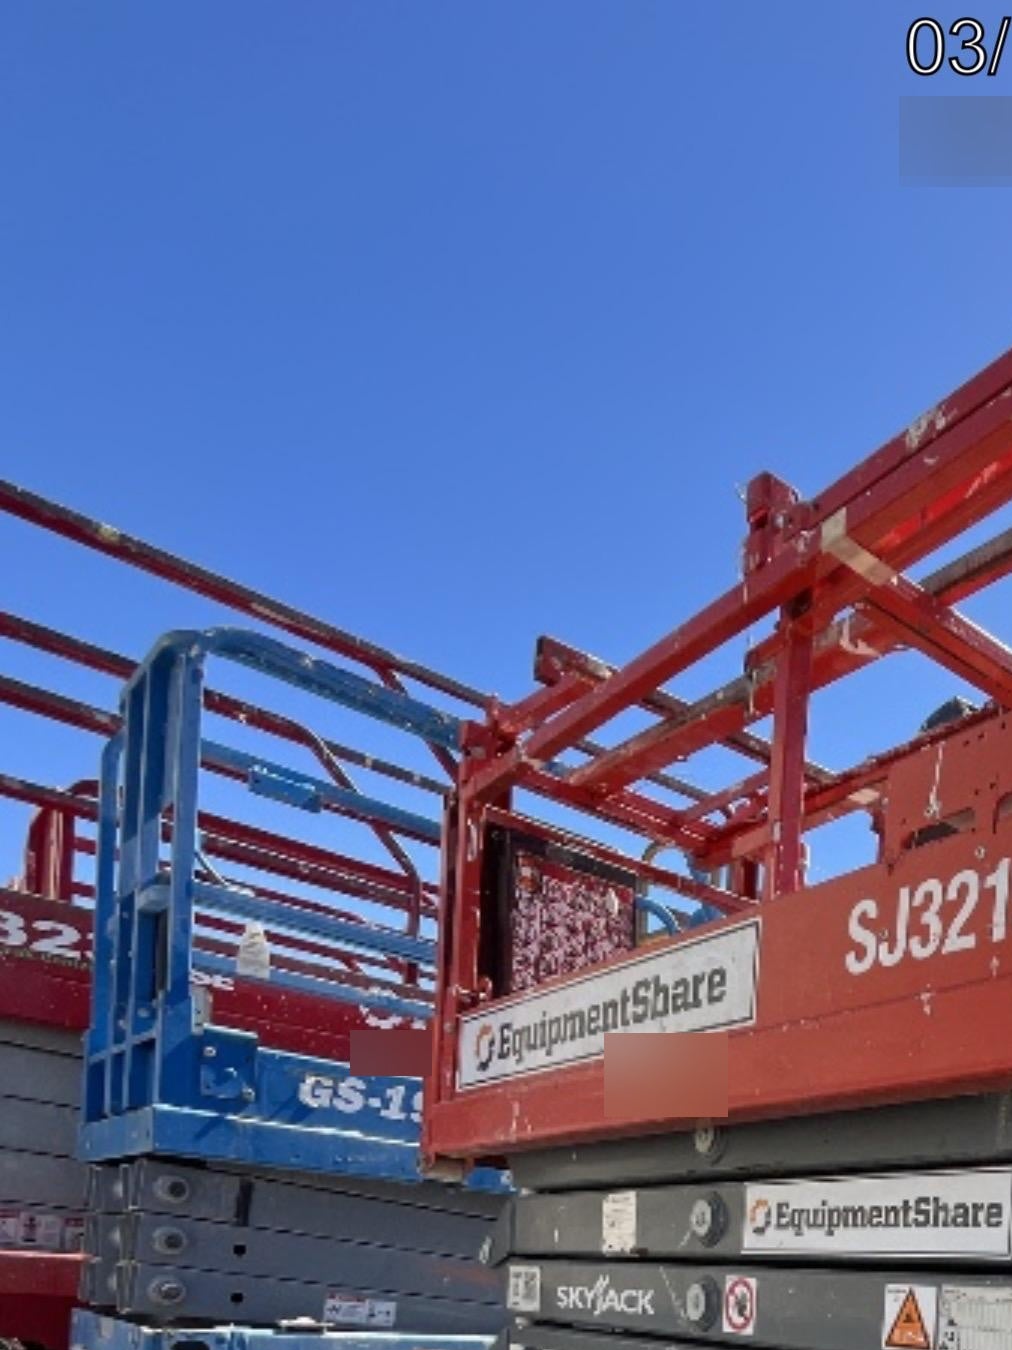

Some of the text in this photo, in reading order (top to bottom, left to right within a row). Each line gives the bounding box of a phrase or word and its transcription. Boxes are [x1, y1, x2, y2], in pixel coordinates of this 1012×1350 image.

[498, 966, 727, 1063] EquipmentShare
[774, 1196, 1003, 1237] EquipmentShare
[556, 1273, 656, 1317] SKYJACK
